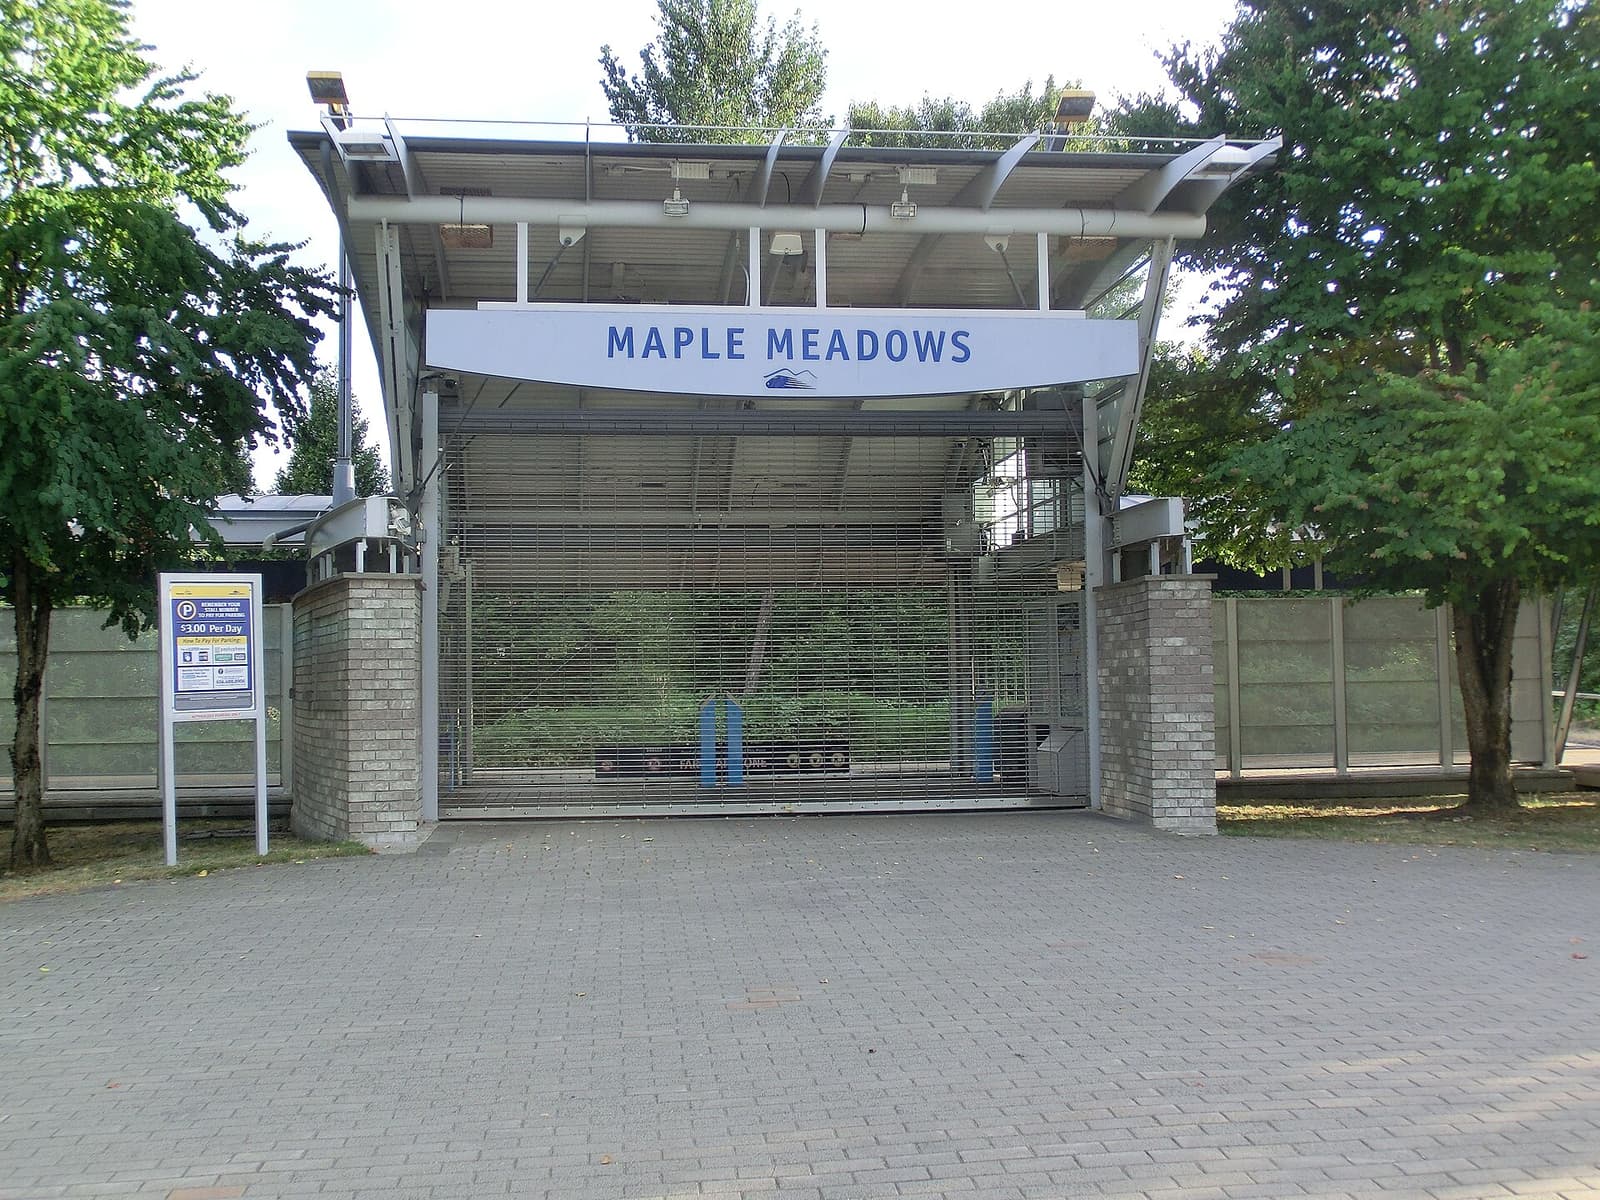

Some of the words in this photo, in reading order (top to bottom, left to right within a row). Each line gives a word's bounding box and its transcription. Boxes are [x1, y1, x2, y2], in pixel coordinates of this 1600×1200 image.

[607, 327, 745, 360] MAPLE
[767, 328, 972, 363] MEADOWS
[181, 624, 206, 633] $3.00
[209, 625, 224, 633] Per
[225, 624, 242, 634] Day
